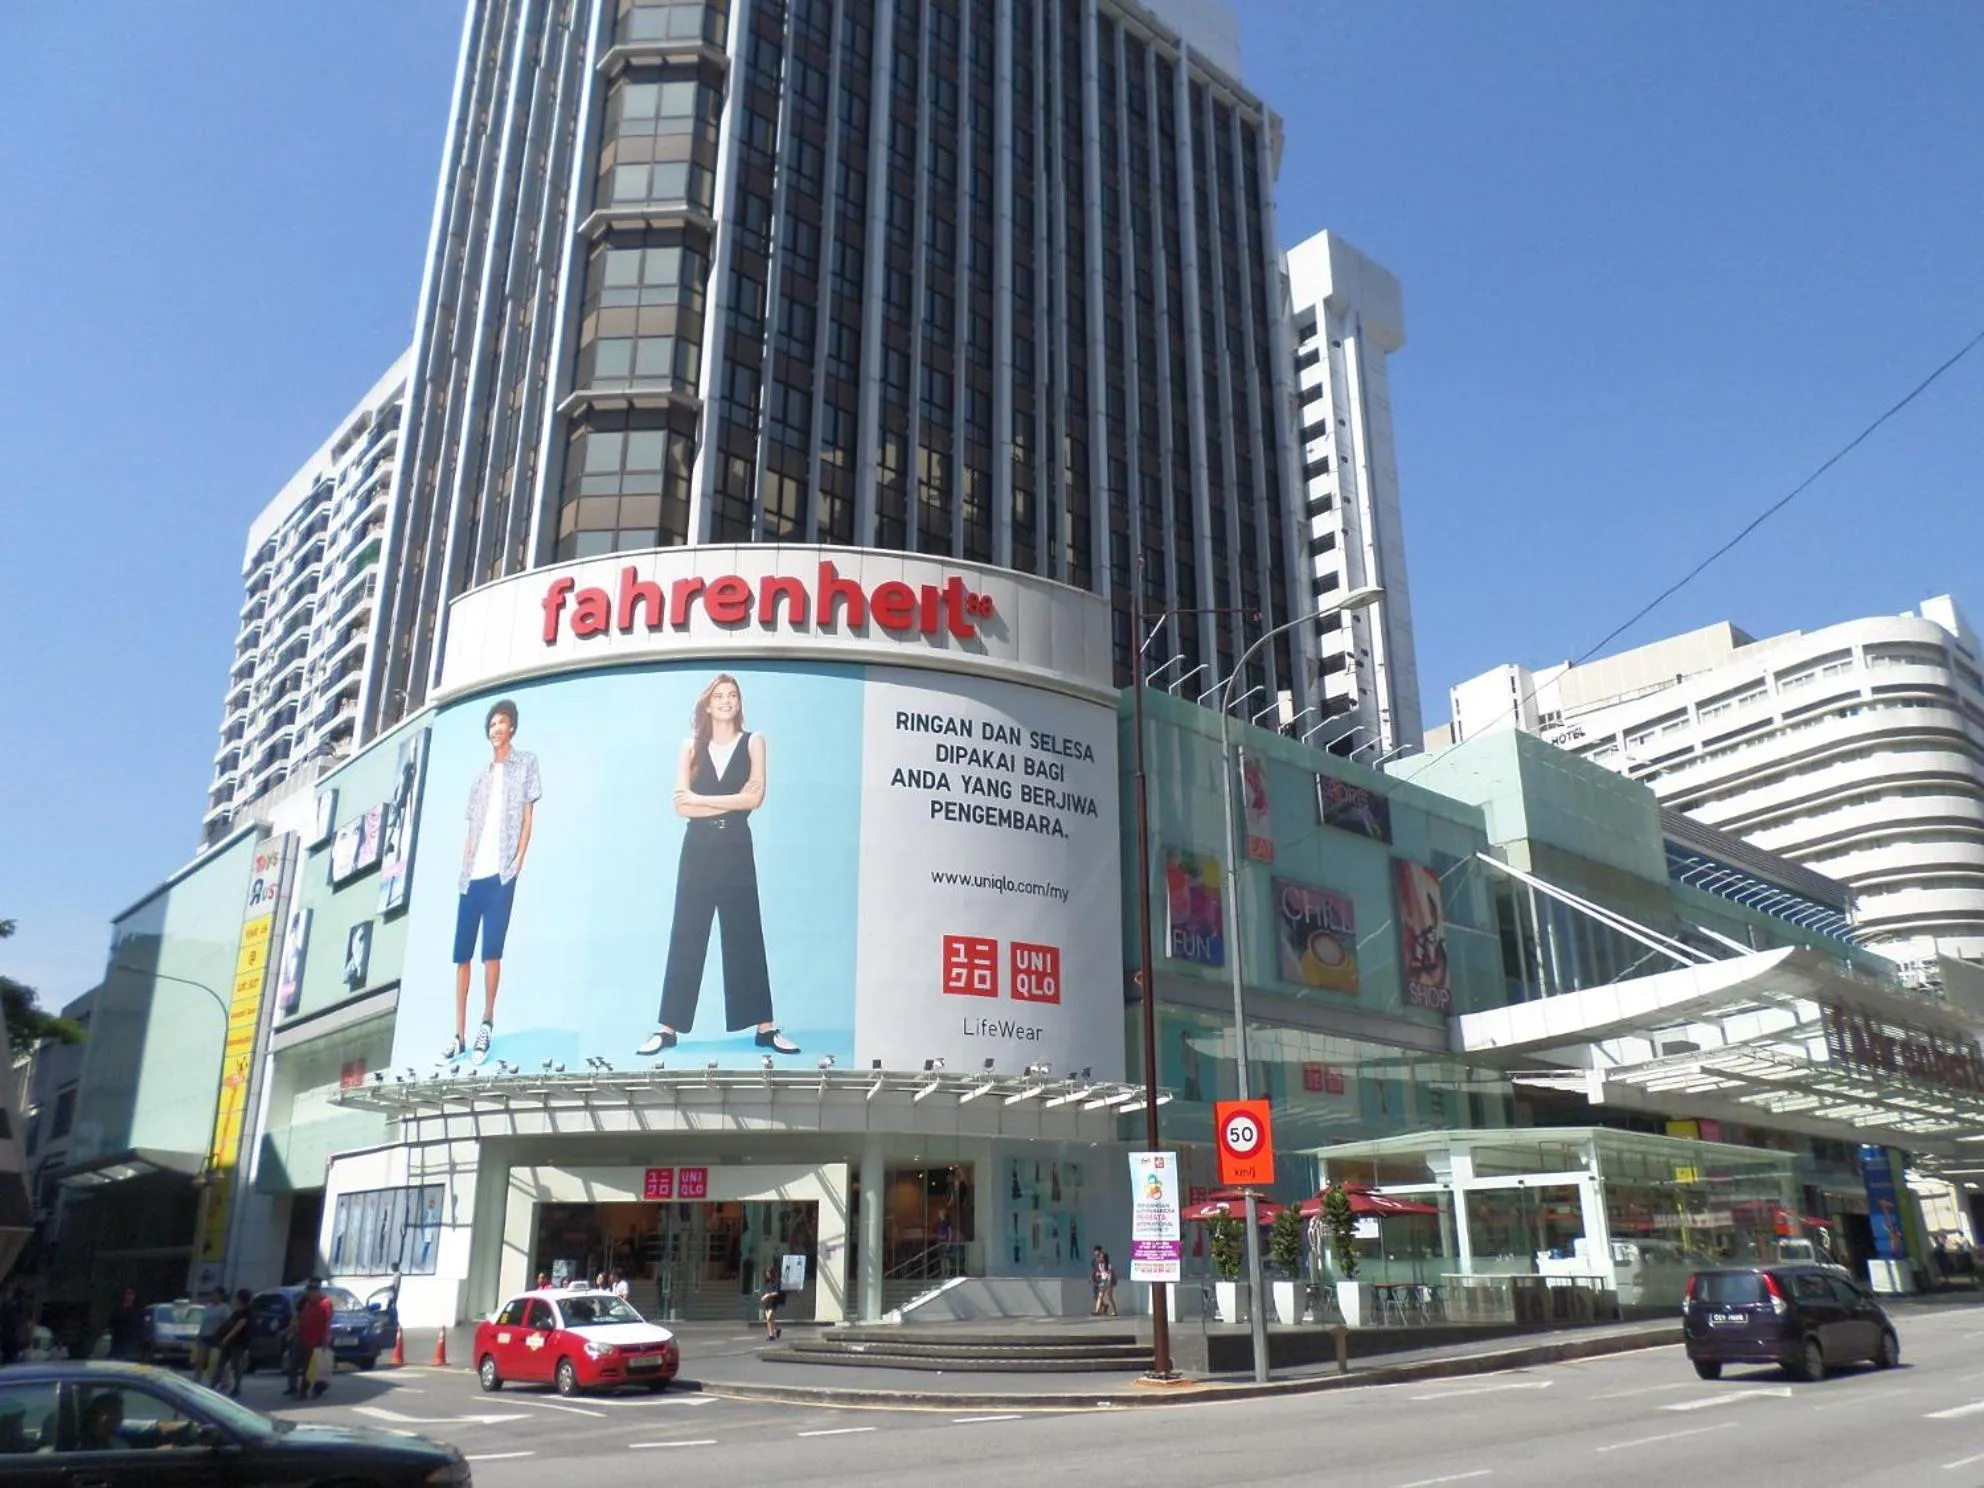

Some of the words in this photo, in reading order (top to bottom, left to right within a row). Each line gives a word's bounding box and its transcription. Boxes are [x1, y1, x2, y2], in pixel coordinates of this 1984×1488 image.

[541, 560, 977, 646] fahrenheit
[966, 592, 993, 618] 88
[896, 711, 973, 738] RINGAN
[982, 721, 1021, 746] DAN
[1029, 731, 1095, 763] SELESA
[1552, 731, 1586, 745] HOTEL
[936, 743, 1015, 773] DIPAKAI
[1024, 756, 1065, 782] BAGI
[891, 768, 951, 792] ANDA
[961, 774, 1012, 800] YANG
[1020, 784, 1098, 818] BERJIWA
[930, 800, 1069, 839] PENGEMBARA.
[931, 871, 1069, 903] www.uniqlo.com/my
[1282, 886, 1353, 935] CHILL
[1172, 932, 1211, 959] FUN
[1409, 982, 1449, 1009] SHOP
[963, 1017, 1043, 1042] LifeWear
[1230, 1126, 1253, 1143] 50
